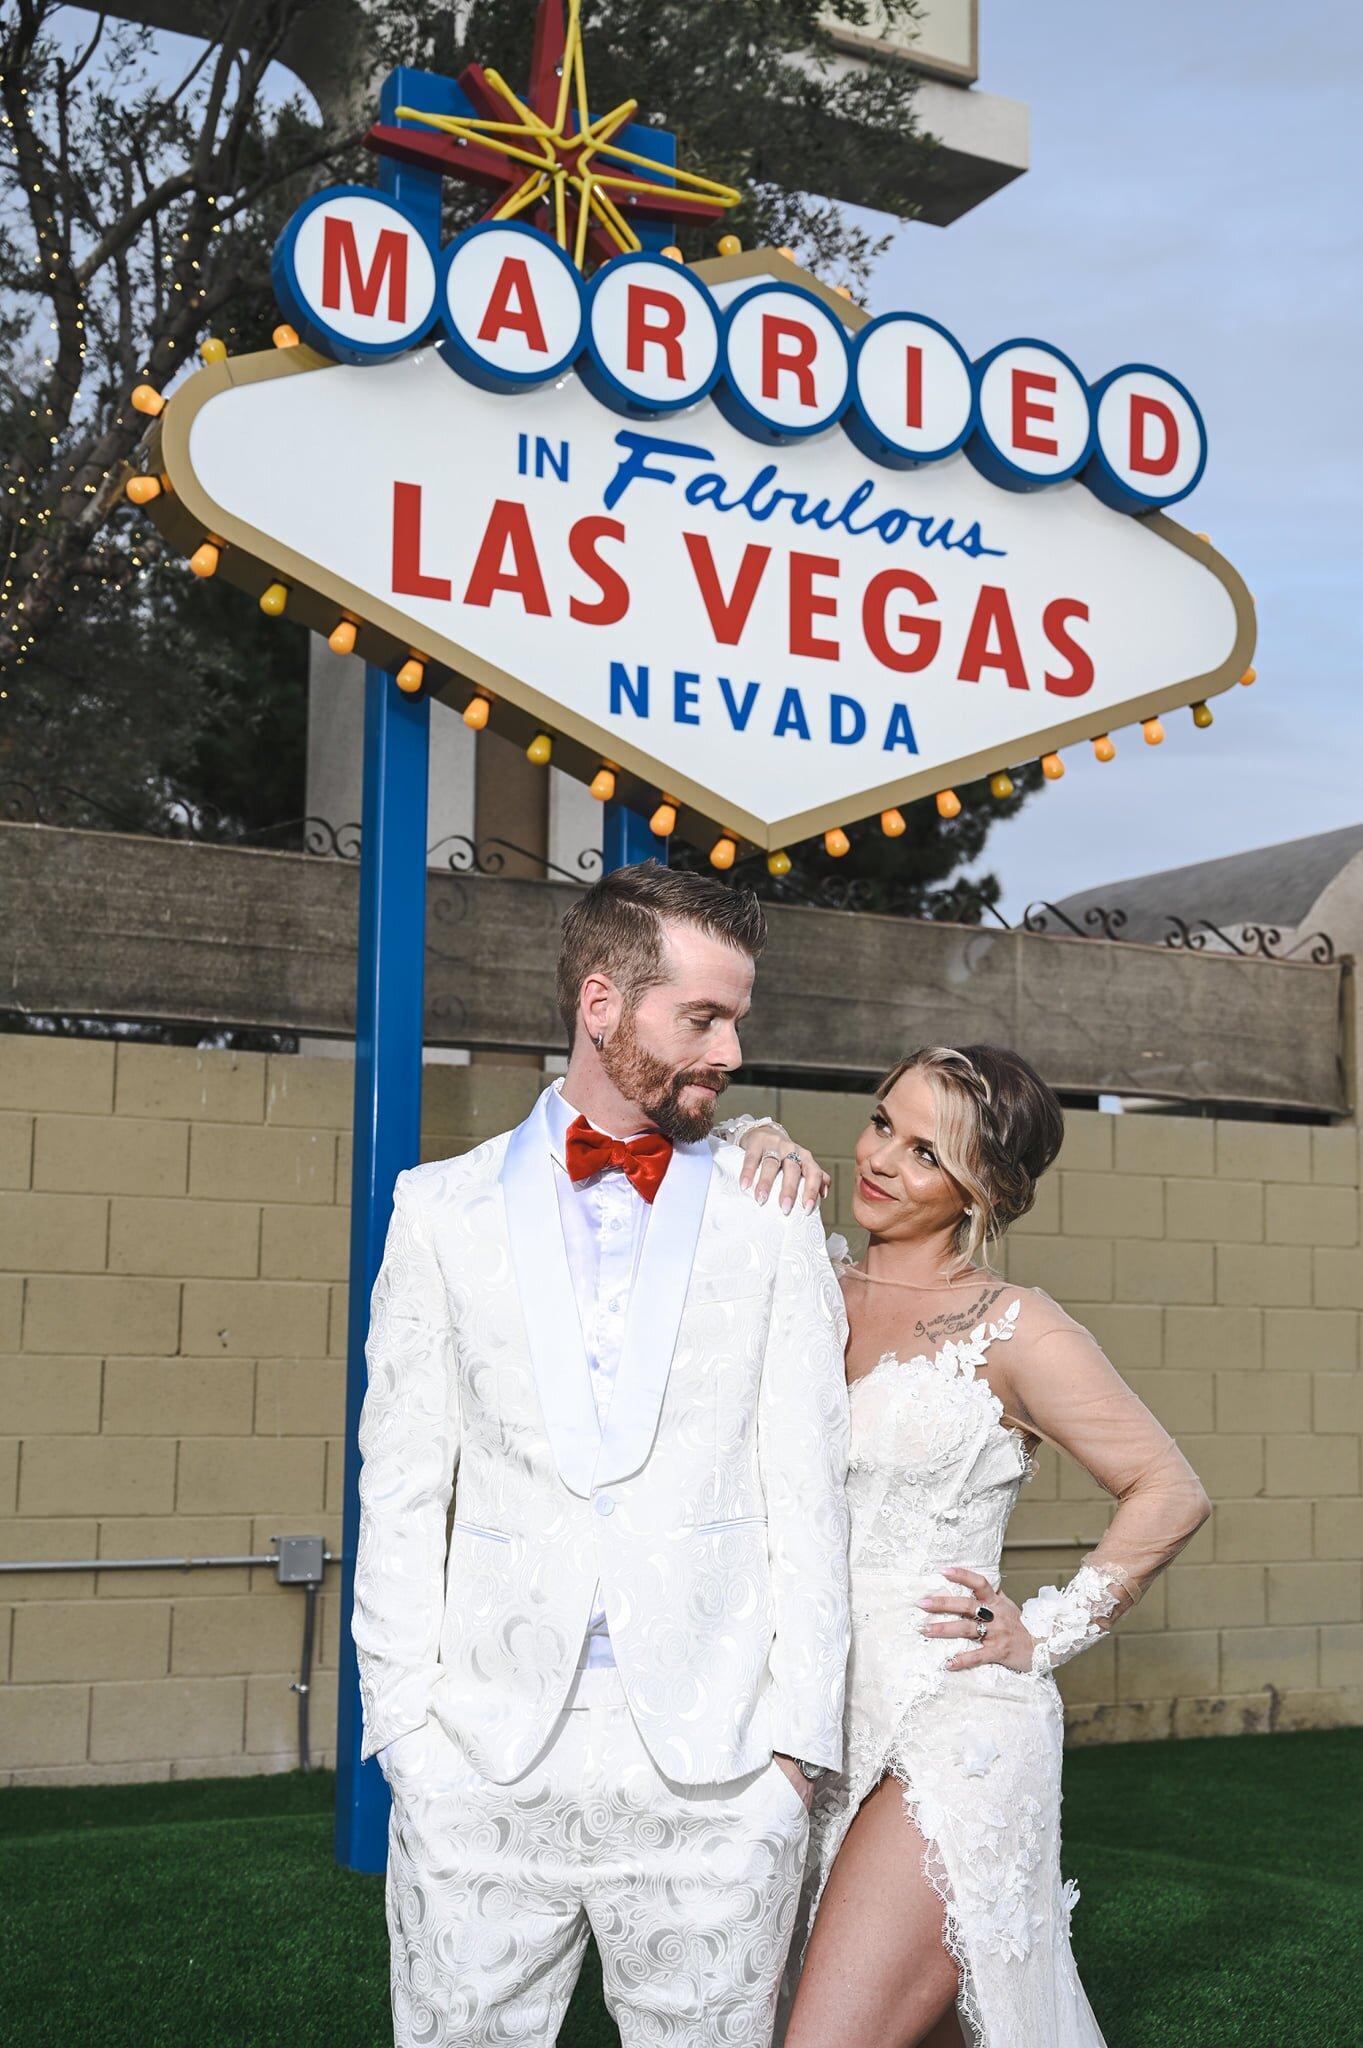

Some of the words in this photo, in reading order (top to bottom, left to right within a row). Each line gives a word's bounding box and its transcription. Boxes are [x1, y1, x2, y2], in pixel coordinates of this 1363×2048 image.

[321, 216, 1180, 477] MARRIED
[517, 433, 571, 484] IN
[603, 430, 1006, 560] Fabulous
[391, 481, 631, 627] LAS
[682, 531, 1096, 699] VEGAS
[608, 660, 920, 756] NEVADA
